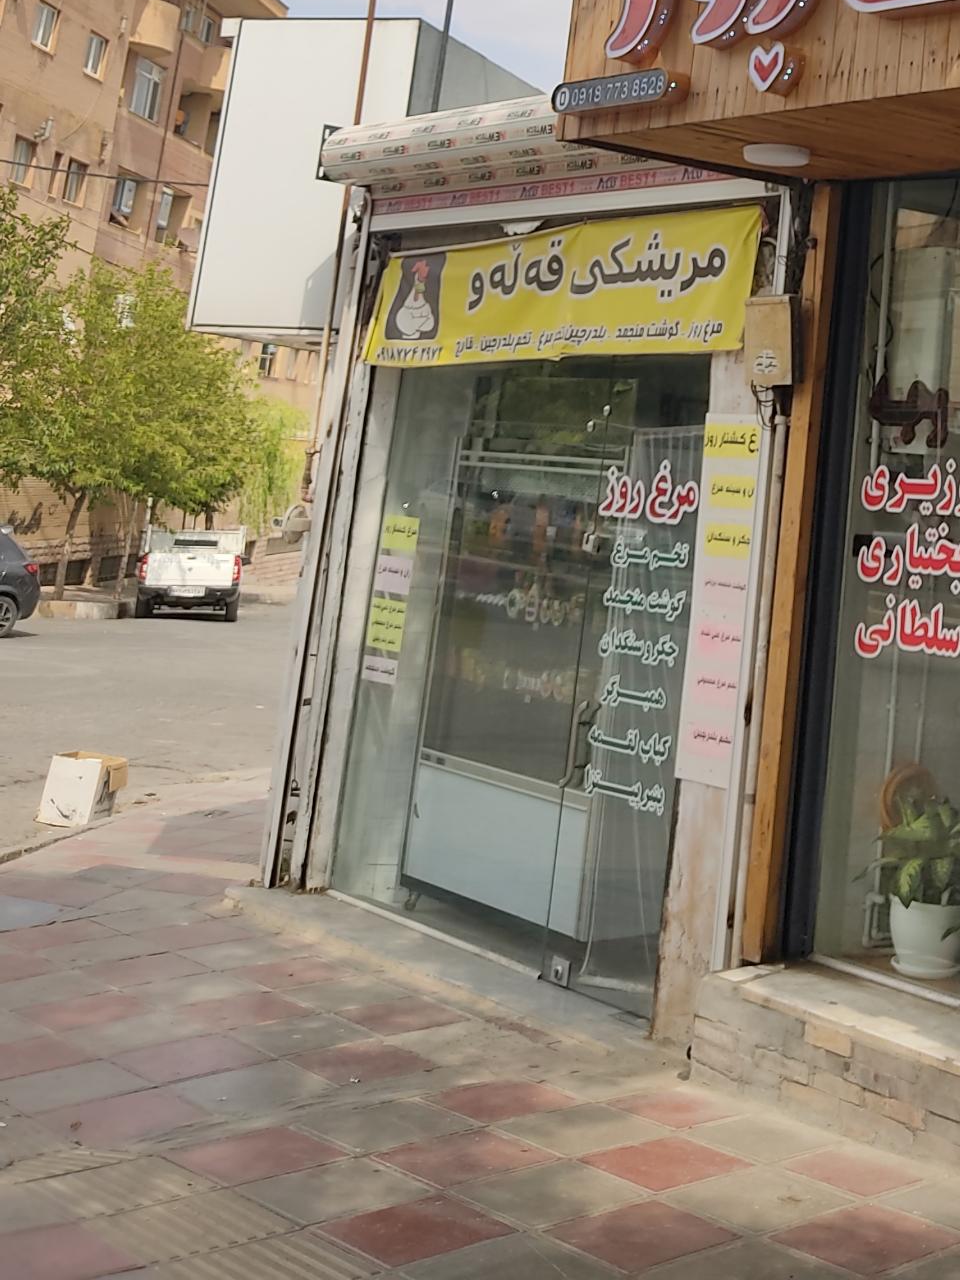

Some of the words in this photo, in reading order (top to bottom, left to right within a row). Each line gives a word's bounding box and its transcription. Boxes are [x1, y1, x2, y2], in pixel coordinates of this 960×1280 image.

[571, 86, 602, 106] 0918
[606, 82, 629, 100] 773
[647, 318, 681, 340] گوشت
[598, 465, 645, 519] روز
[646, 459, 699, 525] مرغ
[603, 585, 646, 615] منجمد
[647, 588, 687, 622] گوشت
[599, 627, 645, 657] سنگدان
[651, 634, 679, 667] جگر
[601, 674, 666, 711] همبرگر
[588, 725, 639, 755] لقمه
[640, 733, 671, 766] کباب
